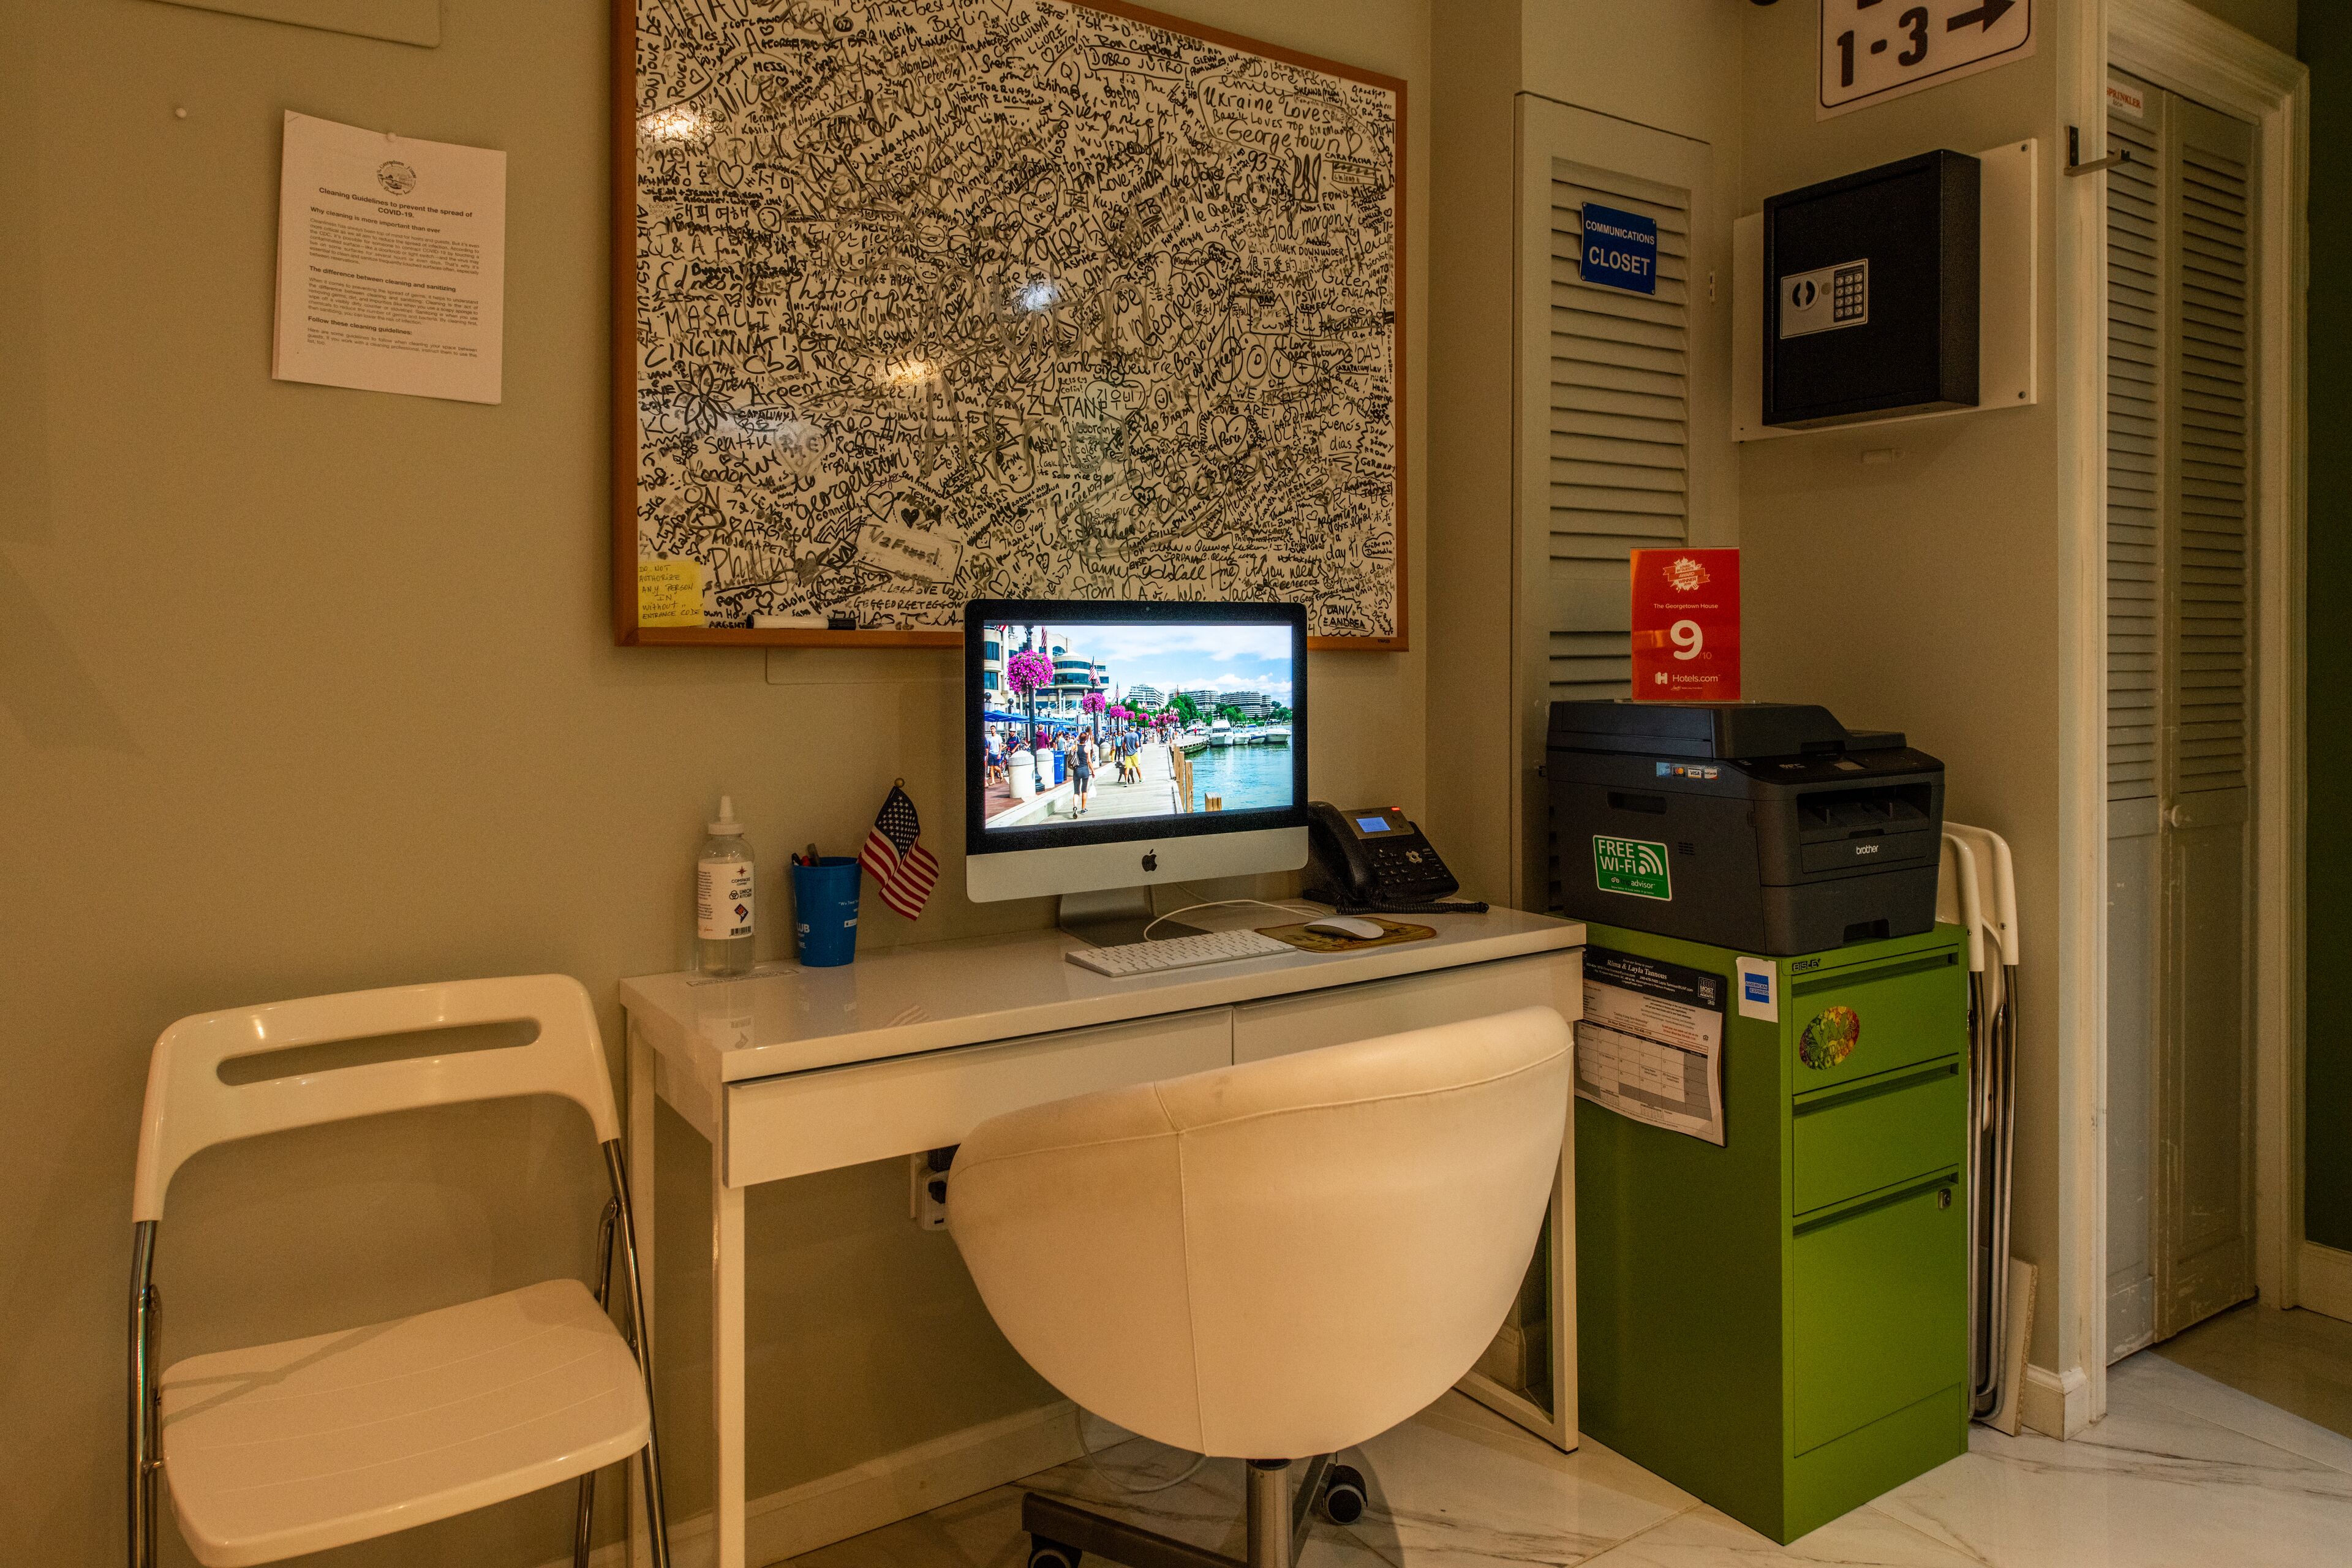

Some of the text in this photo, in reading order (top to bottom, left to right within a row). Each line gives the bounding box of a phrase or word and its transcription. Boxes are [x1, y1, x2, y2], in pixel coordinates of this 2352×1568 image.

[1090, 47, 1183, 74] DOBRO JUTRO
[1226, 119, 1340, 155] Georgetown
[1121, 169, 1164, 202] CANADA
[319, 187, 350, 200] Cleaning
[352, 194, 388, 206] Guidelines
[399, 203, 425, 212] prevent
[310, 206, 324, 215] Why
[326, 210, 353, 221] cleaning
[380, 220, 410, 230] important
[310, 218, 337, 227] Cleanliness
[378, 207, 414, 218] COVID-19.
[1586, 221, 1655, 244] COMMUNICATIONS
[1589, 246, 1650, 276] CLOSET
[323, 268, 355, 278] difference
[356, 273, 383, 282] between
[385, 279, 412, 287] cleaning
[426, 284, 456, 293] sanitizing
[308, 315, 329, 324] Follow
[350, 323, 377, 332] cleaning
[1027, 396, 1096, 418] ZLATAN
[665, 582, 693, 595] PERSON
[642, 611, 676, 619] ENTRANCE
[1670, 619, 1703, 660] 9
[1598, 839, 1635, 858] FREE
[1856, 845, 1879, 855] brother
[1600, 856, 1636, 874] WI-FI
[1607, 959, 1621, 968] Rima
[1628, 965, 1643, 974] Layla
[1645, 968, 1667, 979] Tannous
[1792, 959, 1821, 971] BISLEY
